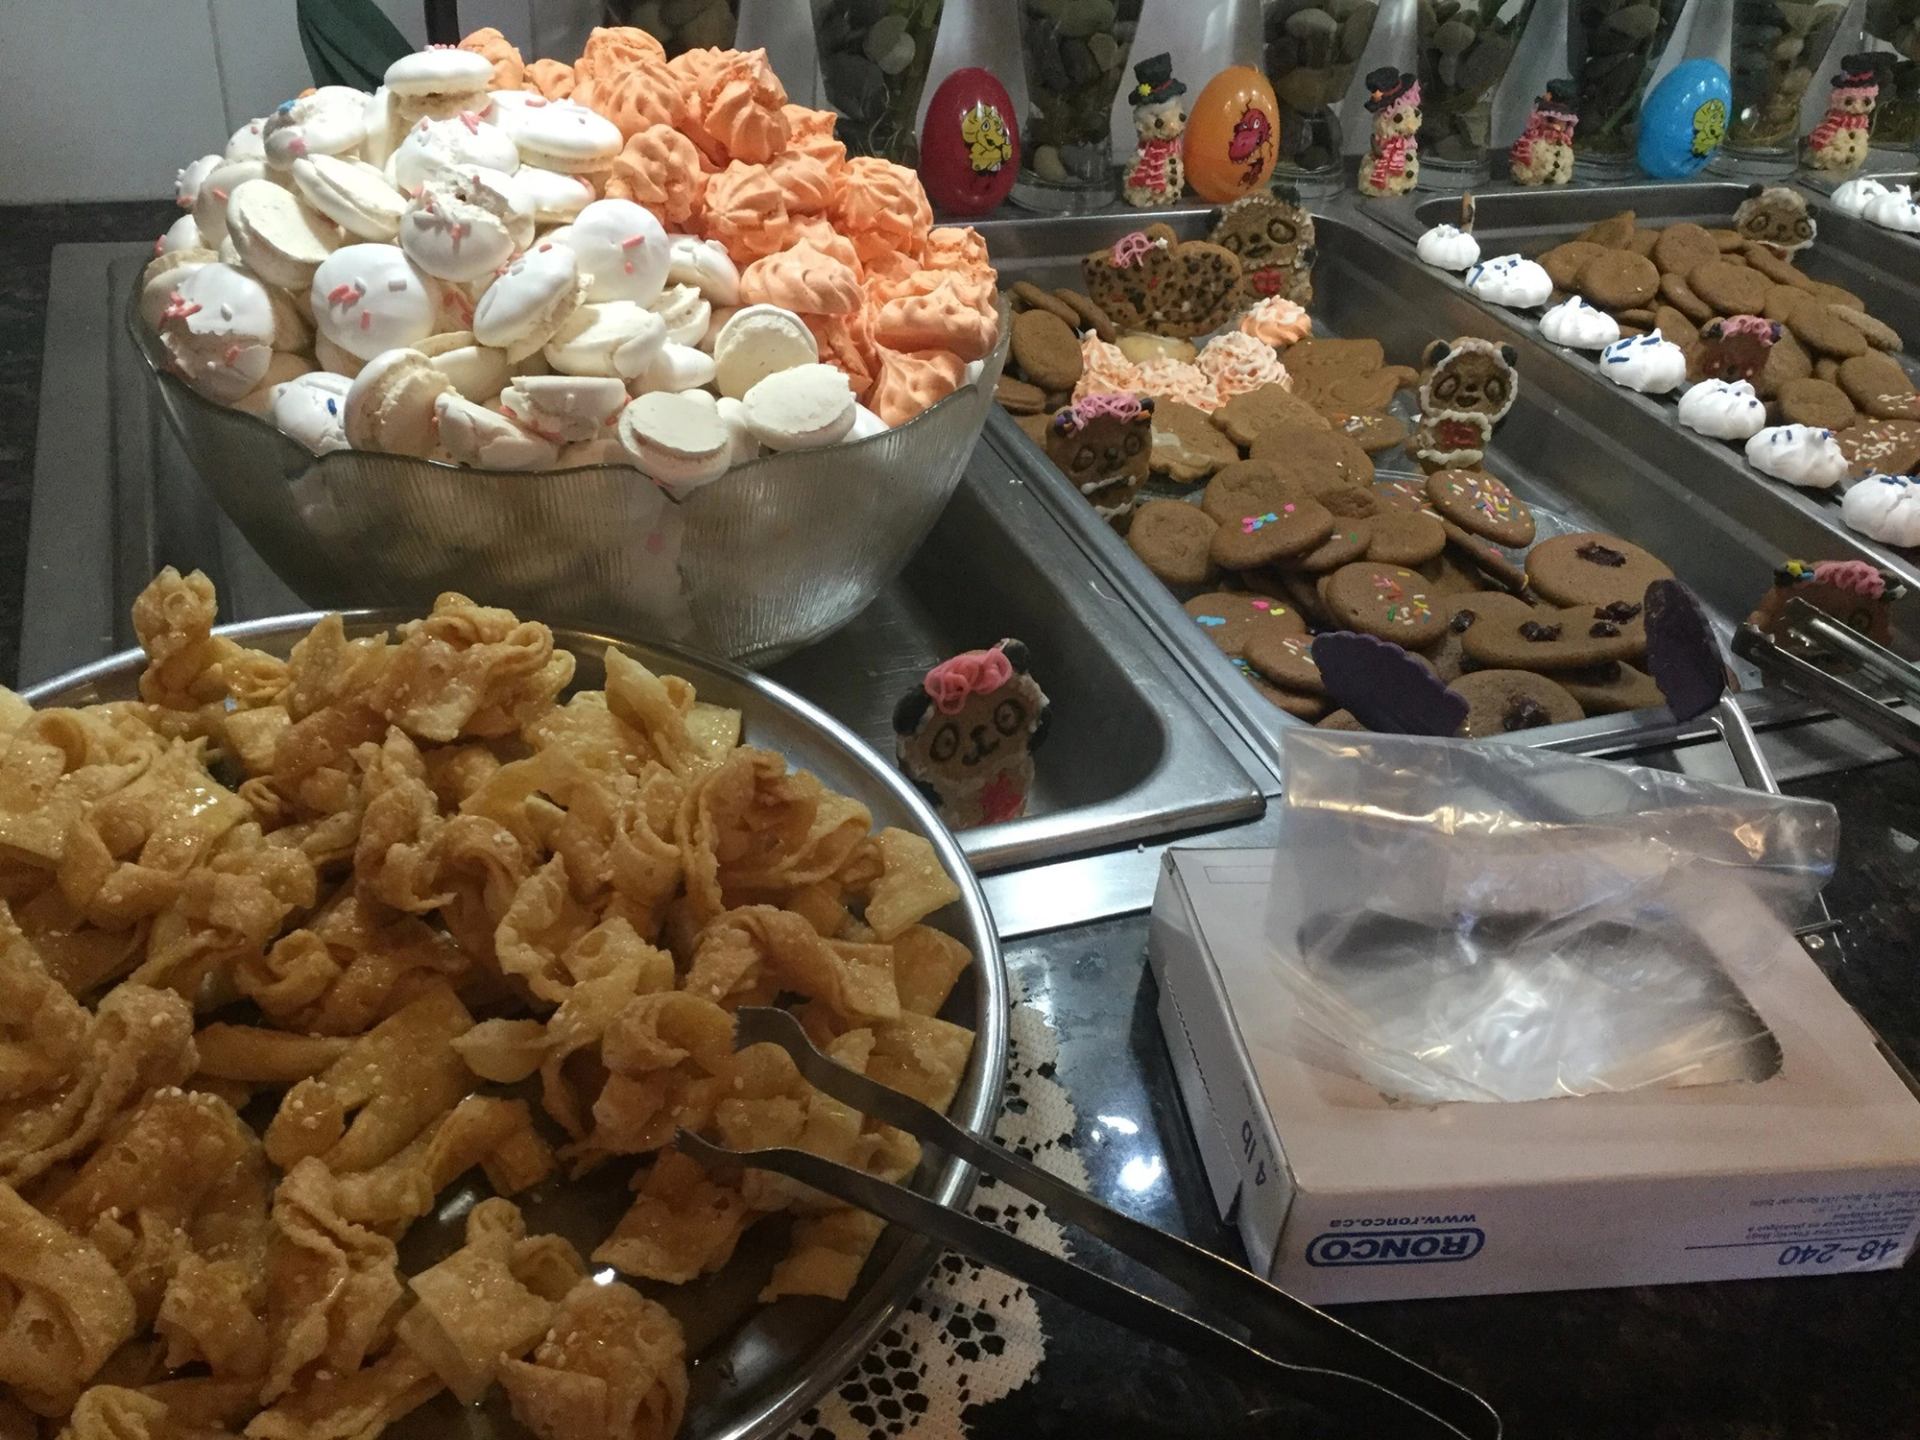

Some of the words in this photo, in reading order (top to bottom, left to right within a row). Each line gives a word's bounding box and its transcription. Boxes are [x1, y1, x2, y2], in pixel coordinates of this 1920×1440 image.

[1329, 1214, 1476, 1228] www.ronco.ca
[1320, 1235, 1471, 1261] RONCO
[1777, 1239, 1899, 1266] 48-240
